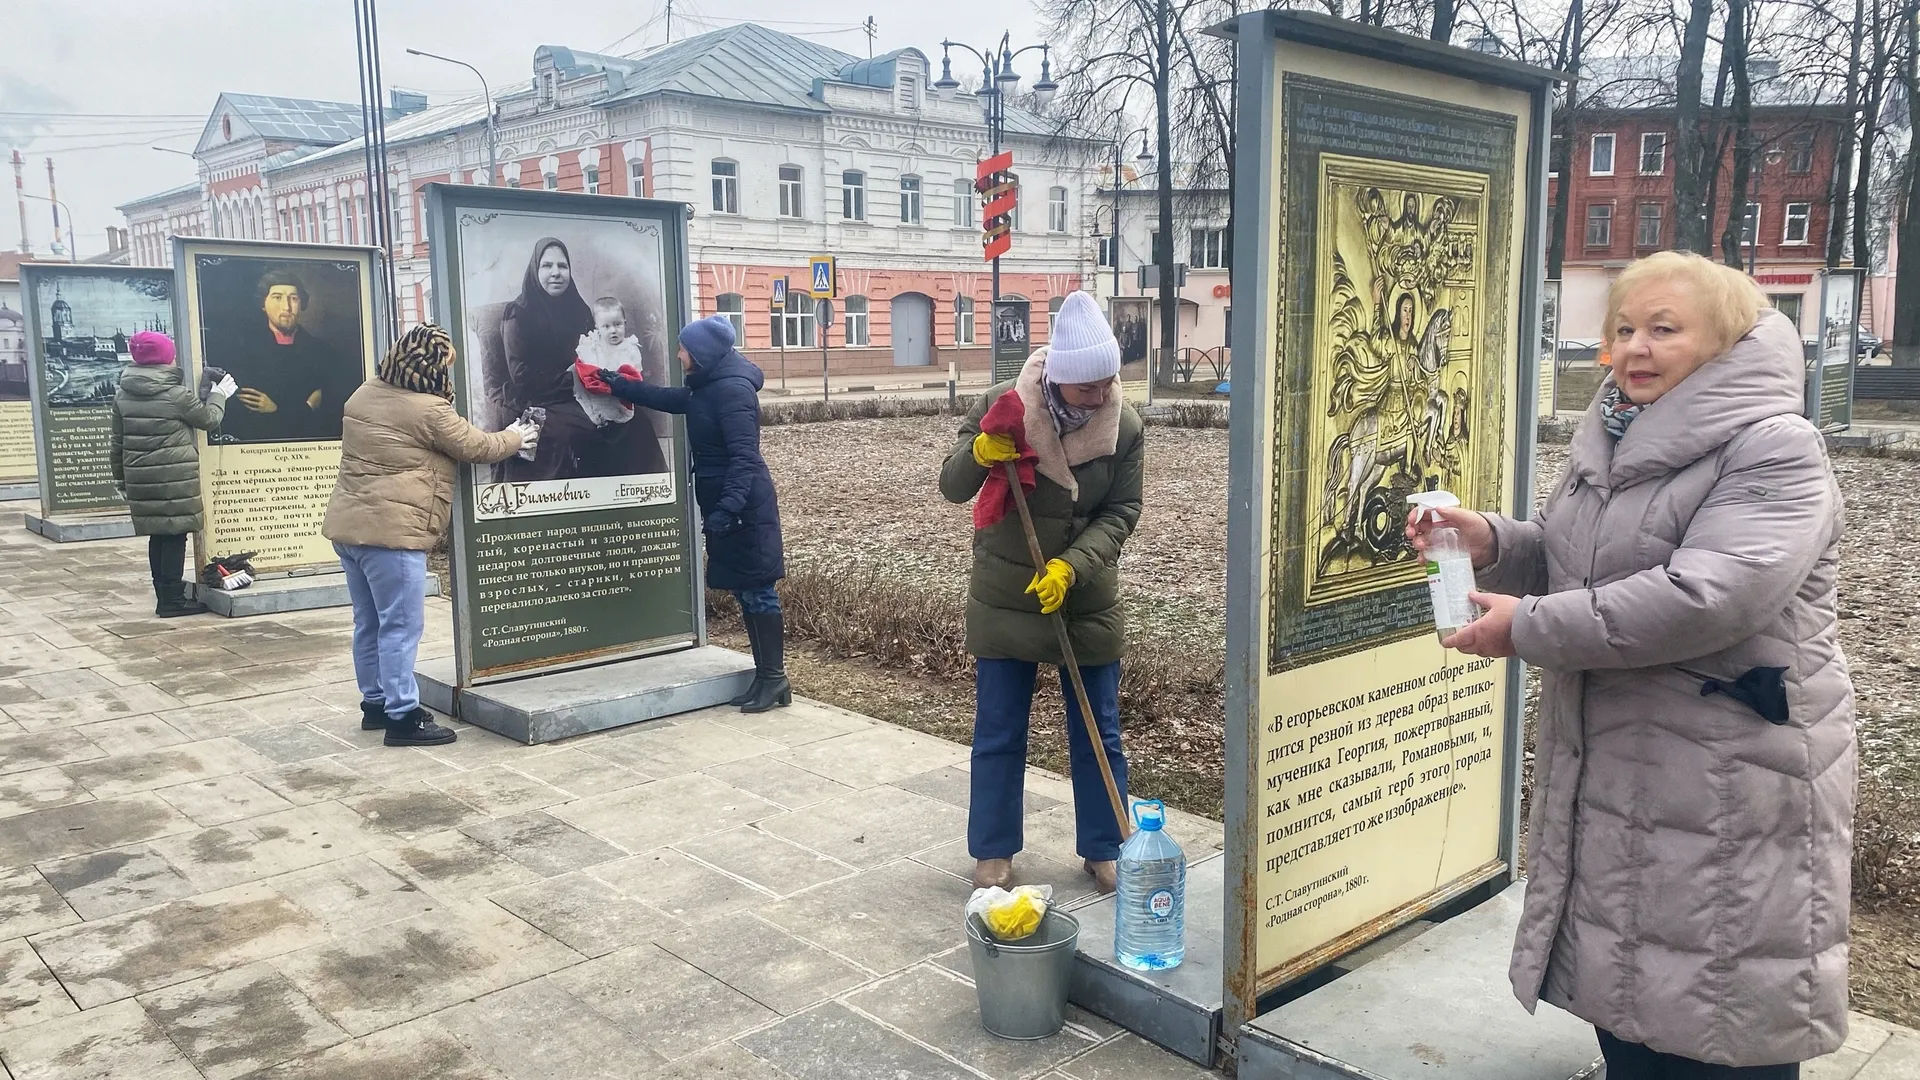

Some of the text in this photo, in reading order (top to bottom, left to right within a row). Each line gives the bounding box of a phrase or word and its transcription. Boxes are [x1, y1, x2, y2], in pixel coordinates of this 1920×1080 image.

[240, 447, 281, 455] Кондратий
[274, 454, 290, 462] Сер.
[211, 469, 227, 477] «Да
[244, 468, 282, 477] стрижка
[287, 464, 340, 473] тёмно-русых
[243, 476, 276, 486] чёрных
[212, 488, 260, 497] усиливает
[266, 484, 309, 493] суровость
[213, 497, 267, 507] егорьевцев:
[214, 517, 240, 525] лбом
[249, 504, 307, 513] выстрижены,
[215, 526, 256, 536] бровями,
[260, 523, 299, 533] спущены
[260, 533, 290, 541] одного
[476, 516, 679, 545] «Проживает народ видный, высокорос-
[477, 547, 507, 558] лый,
[514, 538, 585, 555] коренастый
[604, 528, 680, 544] здоровенный;
[478, 541, 680, 571] недаром долговечные люди, дождав-
[478, 574, 513, 586] шиеся
[516, 573, 529, 581] не
[530, 567, 567, 579] только
[569, 563, 607, 575] внуков,
[609, 561, 621, 569] но
[631, 554, 681, 568] правнуков
[480, 584, 549, 600] взрослых,
[568, 574, 624, 587] старики,
[630, 566, 681, 579] которым
[481, 586, 632, 614] перевалило далеко за сто лет».
[482, 617, 567, 637] С.Т. Славутинский
[483, 636, 520, 648] «Родная
[522, 631, 563, 642] сторона»,
[564, 626, 582, 636] 1880
[1267, 656, 1495, 734] «В егорьевском каменном соборе нахо-
[1266, 680, 1494, 766] дится резной из дерева образ велико-
[1266, 701, 1493, 792] мученика Георгия, пожертвованный,
[1266, 725, 1493, 819] как мне сказывали, Романовыми, и,
[1266, 748, 1492, 846] помнится, самый герб этого города
[1266, 782, 1466, 874] представляет то же изображение».
[1266, 865, 1349, 911] С.Т. Славутинский
[1266, 874, 1369, 929] «Родная сторона», 1880 г.
